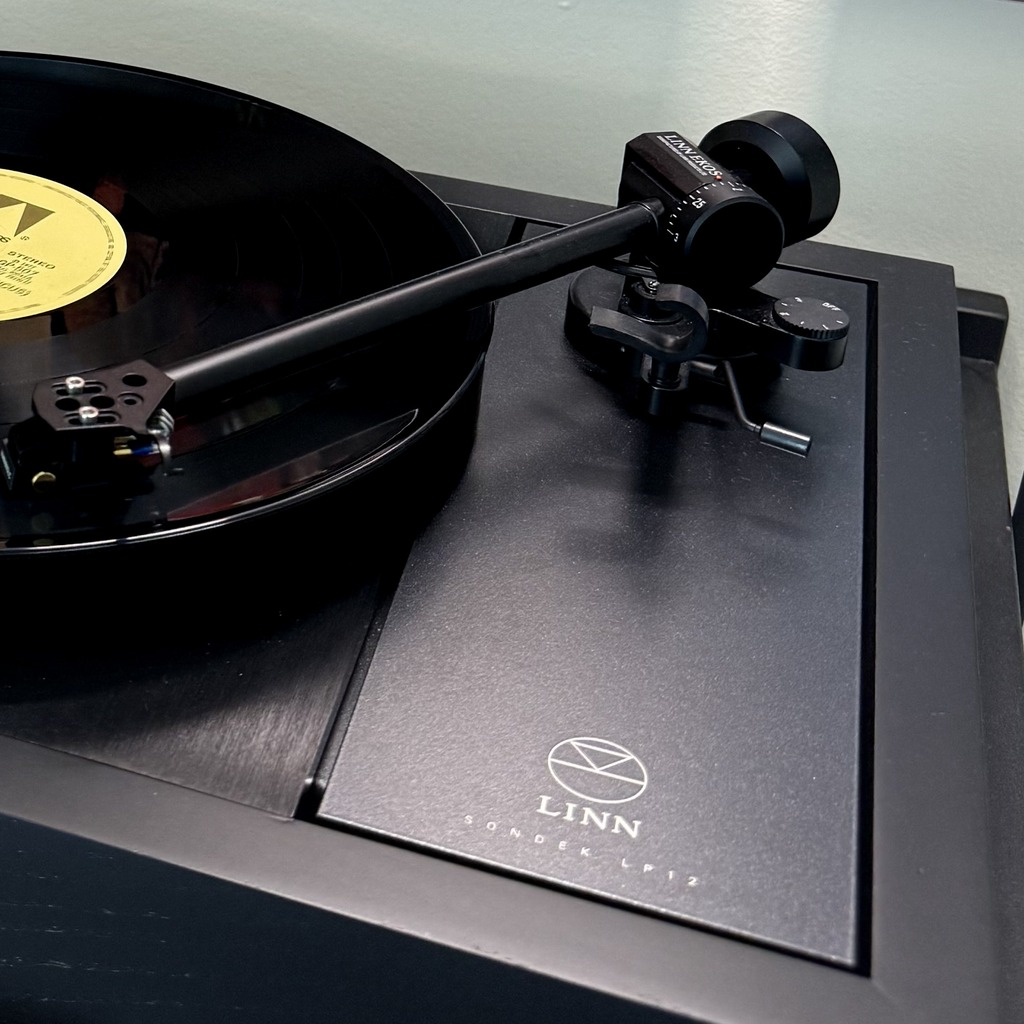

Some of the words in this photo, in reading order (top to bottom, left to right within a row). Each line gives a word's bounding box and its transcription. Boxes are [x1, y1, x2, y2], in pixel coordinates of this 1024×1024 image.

[664, 135, 698, 155] LINN
[690, 156, 724, 177] EKOS
[7, 250, 56, 271] STEREO
[536, 795, 642, 839] LINN
[463, 814, 592, 858] SONDEK
[621, 857, 699, 887] LP12
